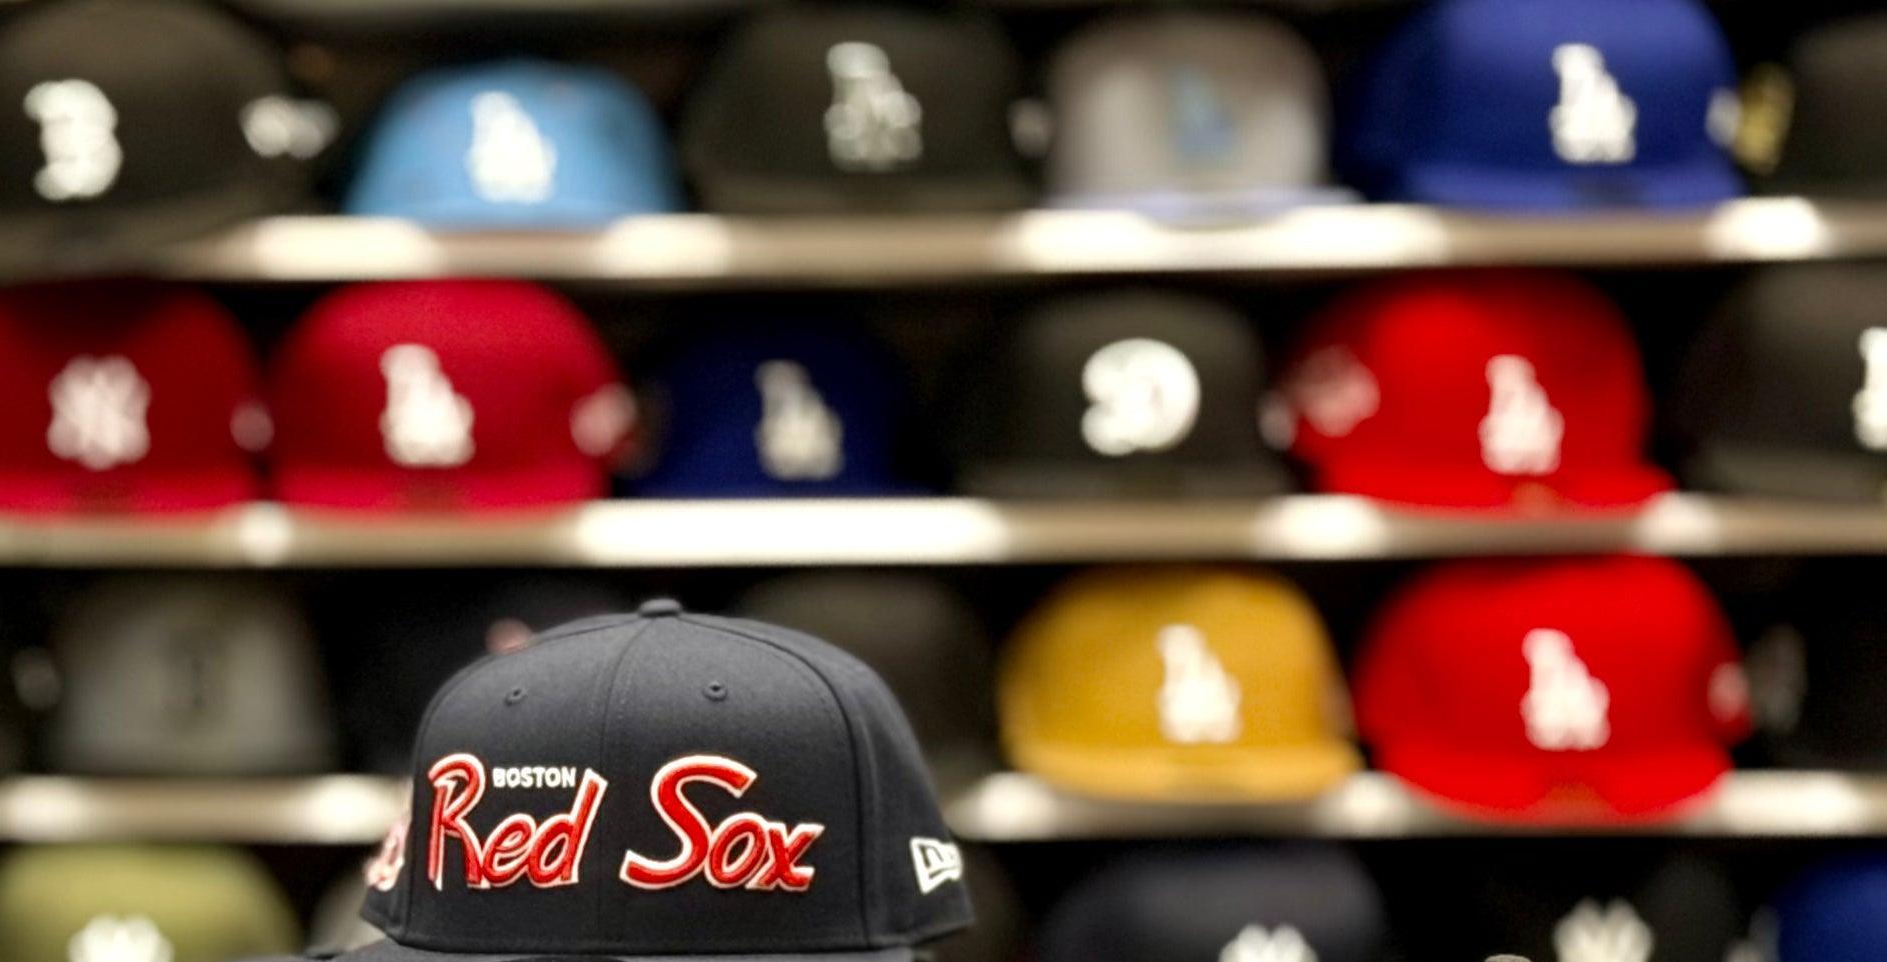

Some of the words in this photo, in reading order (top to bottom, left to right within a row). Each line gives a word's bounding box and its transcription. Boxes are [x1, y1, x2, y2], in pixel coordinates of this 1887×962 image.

[492, 766, 577, 790] BOSTON
[427, 751, 609, 892] Red
[621, 752, 826, 894] Sox
